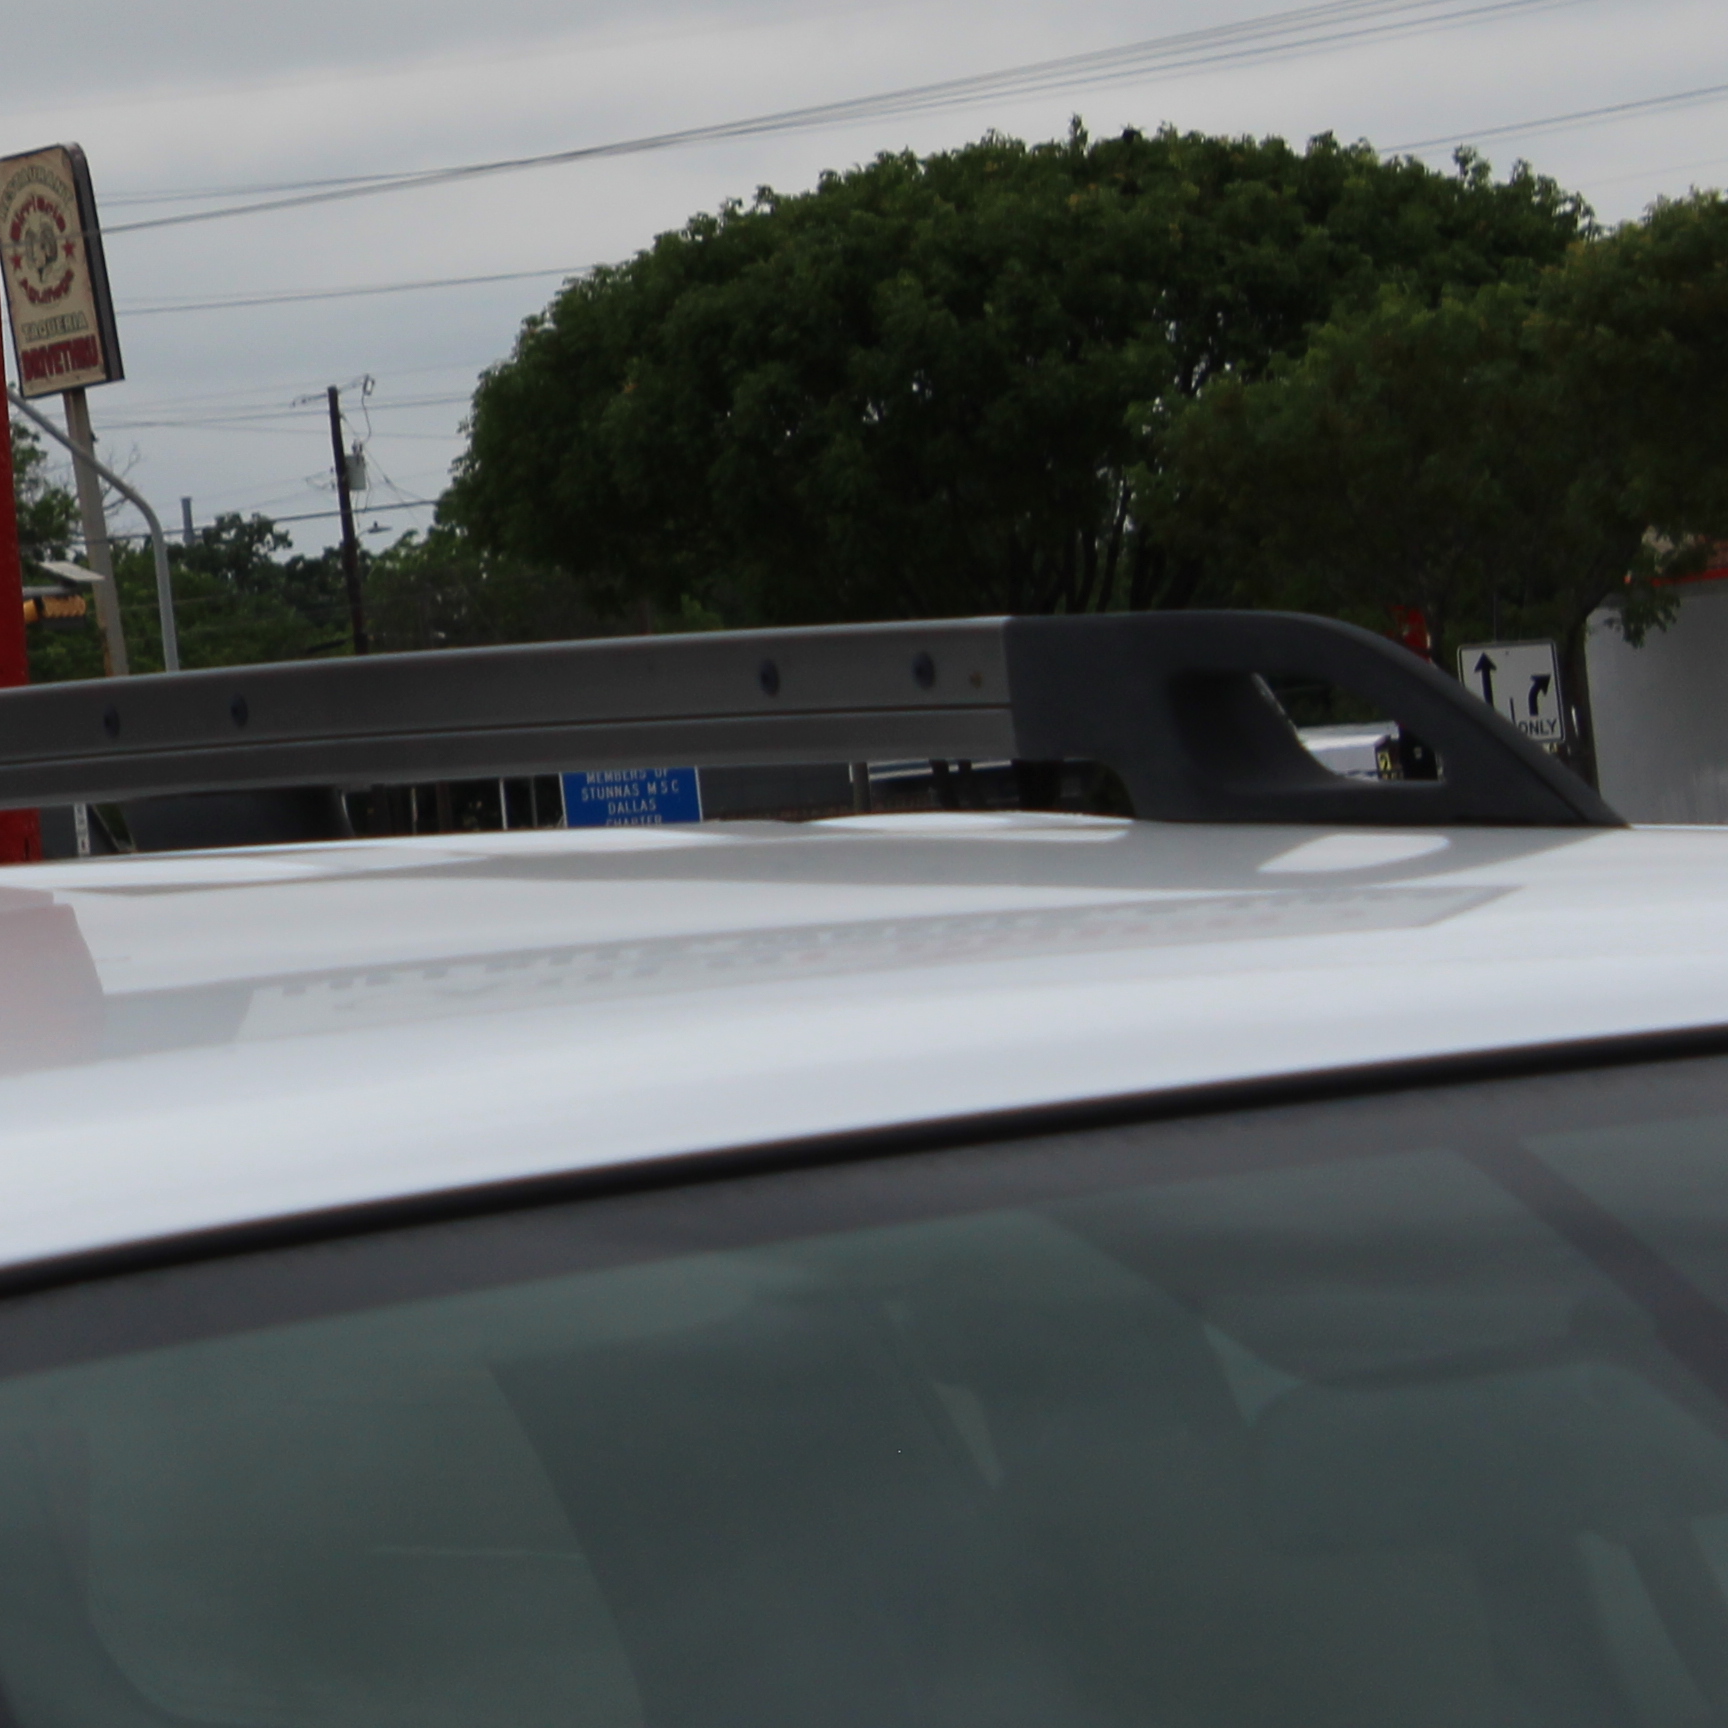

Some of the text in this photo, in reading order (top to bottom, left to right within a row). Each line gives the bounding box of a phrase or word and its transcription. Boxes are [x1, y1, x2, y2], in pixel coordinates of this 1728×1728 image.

[22, 310, 89, 343] TAQUERIA
[1518, 719, 1558, 737] ONLY
[581, 783, 640, 802] STUNNAS
[608, 798, 657, 815] DALLAS
